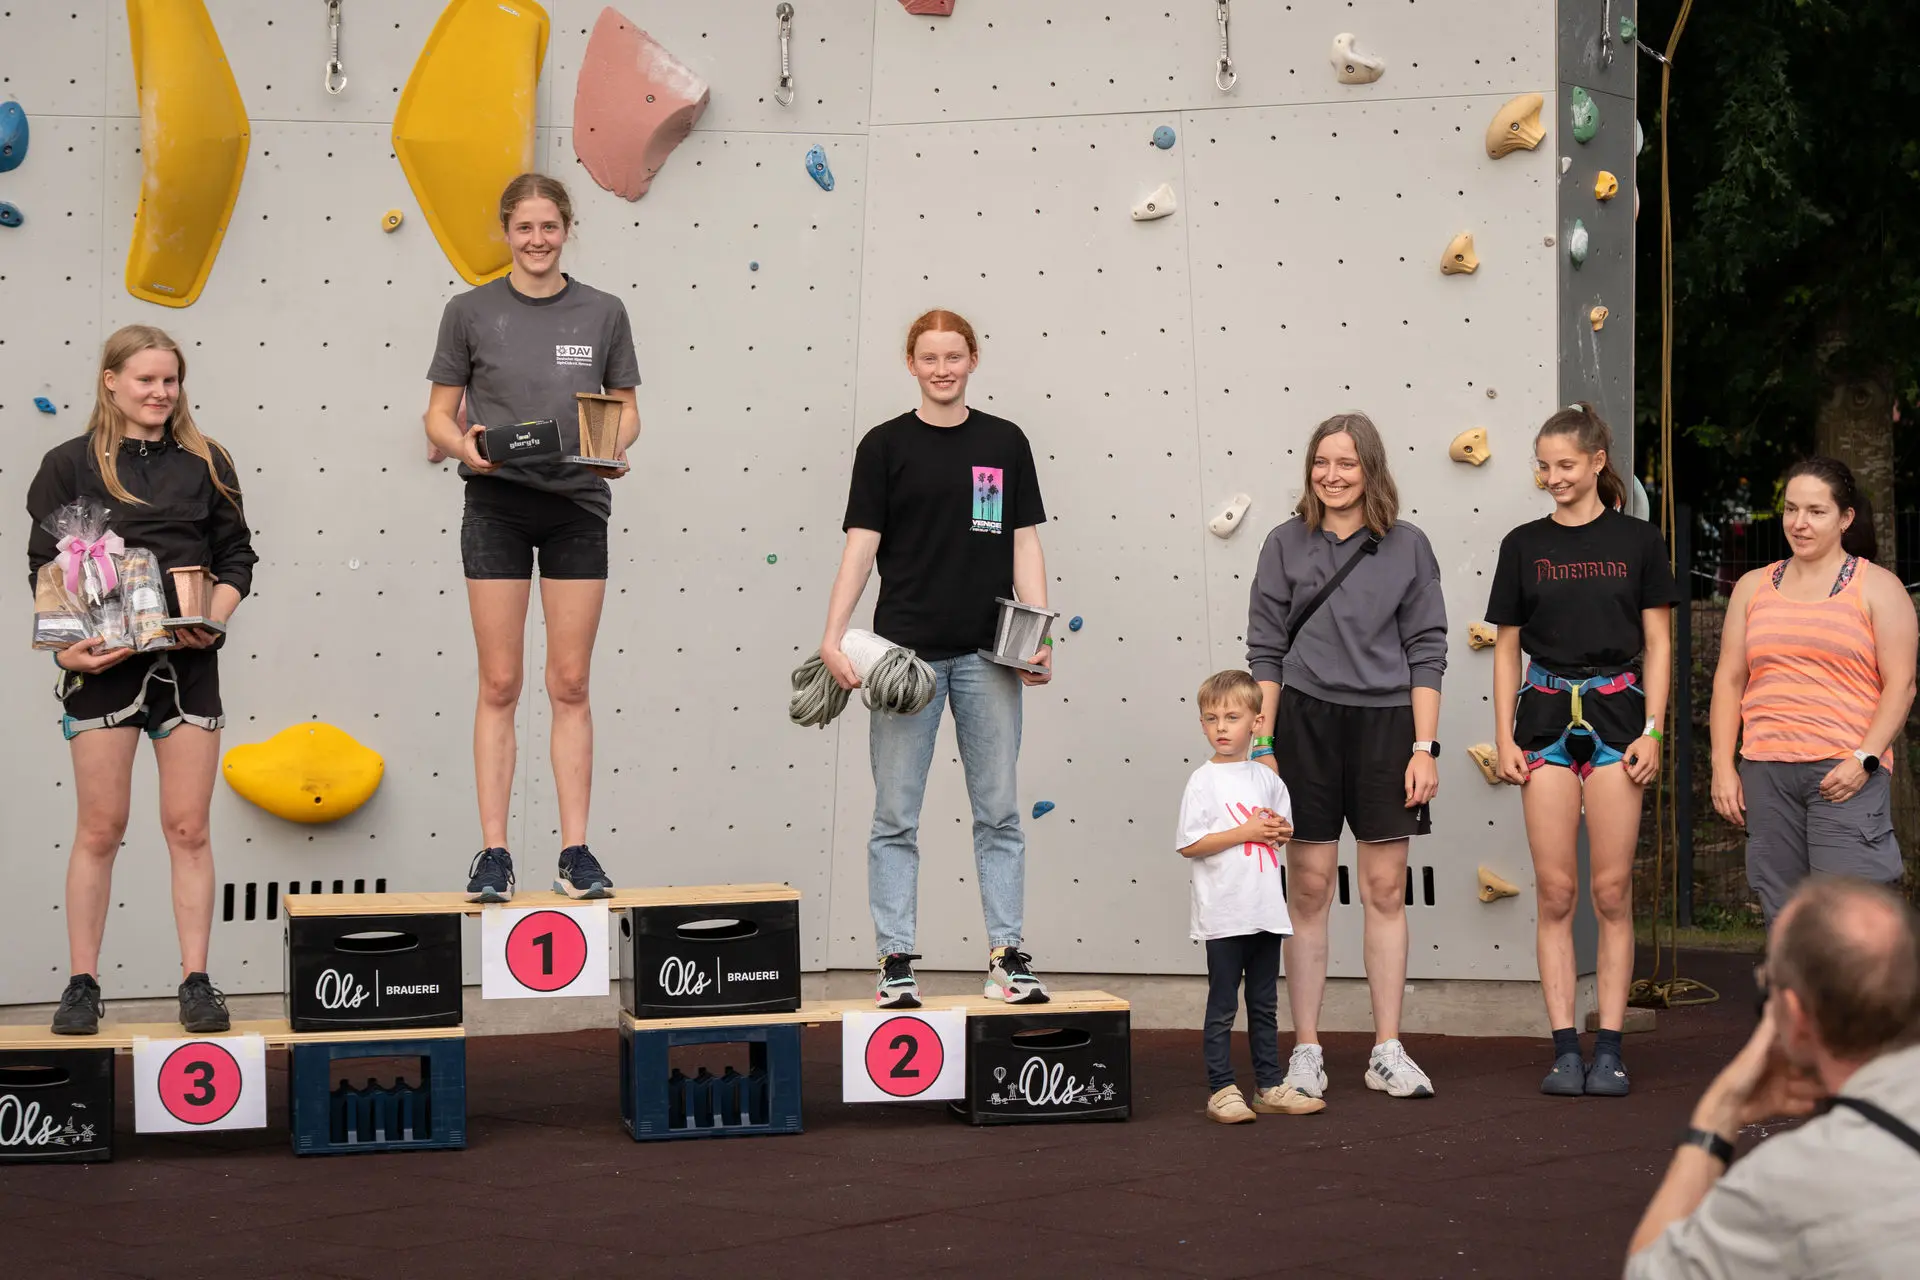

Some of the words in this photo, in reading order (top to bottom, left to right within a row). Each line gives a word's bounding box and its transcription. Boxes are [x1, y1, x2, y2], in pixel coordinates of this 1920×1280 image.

[569, 346, 591, 356] DAV
[532, 931, 553, 975] 1
[315, 968, 370, 1009] Ols
[386, 984, 440, 995] BRAUEREI
[658, 956, 712, 996] Ols
[727, 970, 779, 982] BRAUEREI
[889, 1034, 920, 1079] 2
[183, 1060, 216, 1107] 3
[1019, 1056, 1085, 1106] Ols
